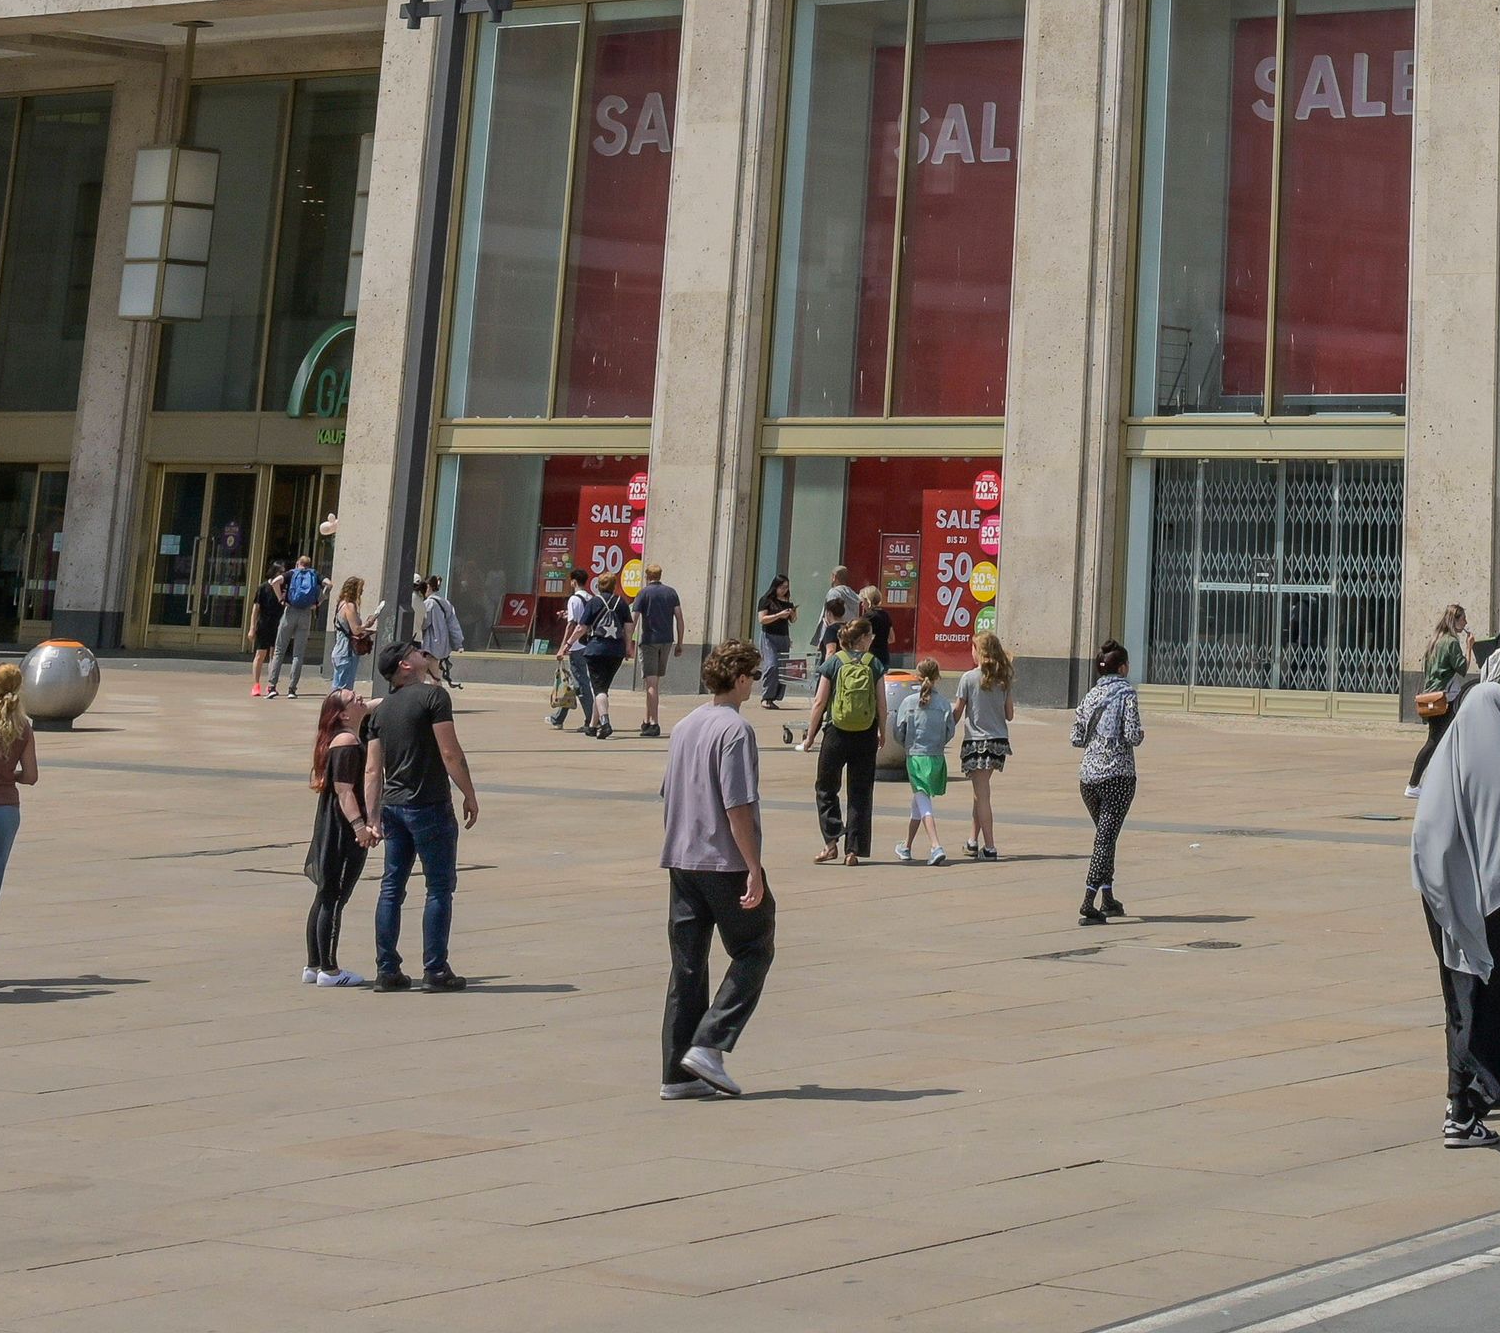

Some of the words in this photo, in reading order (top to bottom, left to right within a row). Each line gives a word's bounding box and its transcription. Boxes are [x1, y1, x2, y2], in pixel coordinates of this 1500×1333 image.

[975, 493, 999, 501] RABATT
[590, 504, 633, 524] SALE
[935, 509, 981, 530] SALE
[599, 529, 609, 538] BIS
[610, 529, 619, 538] ZU
[548, 537, 567, 547] SALE
[946, 535, 958, 544] BIS
[958, 535, 968, 544] ZU
[888, 543, 911, 554] SALE
[591, 544, 623, 575] 50
[936, 551, 974, 583] 50
[971, 584, 996, 592] RABATT
[934, 633, 971, 642] REDUZIERT
